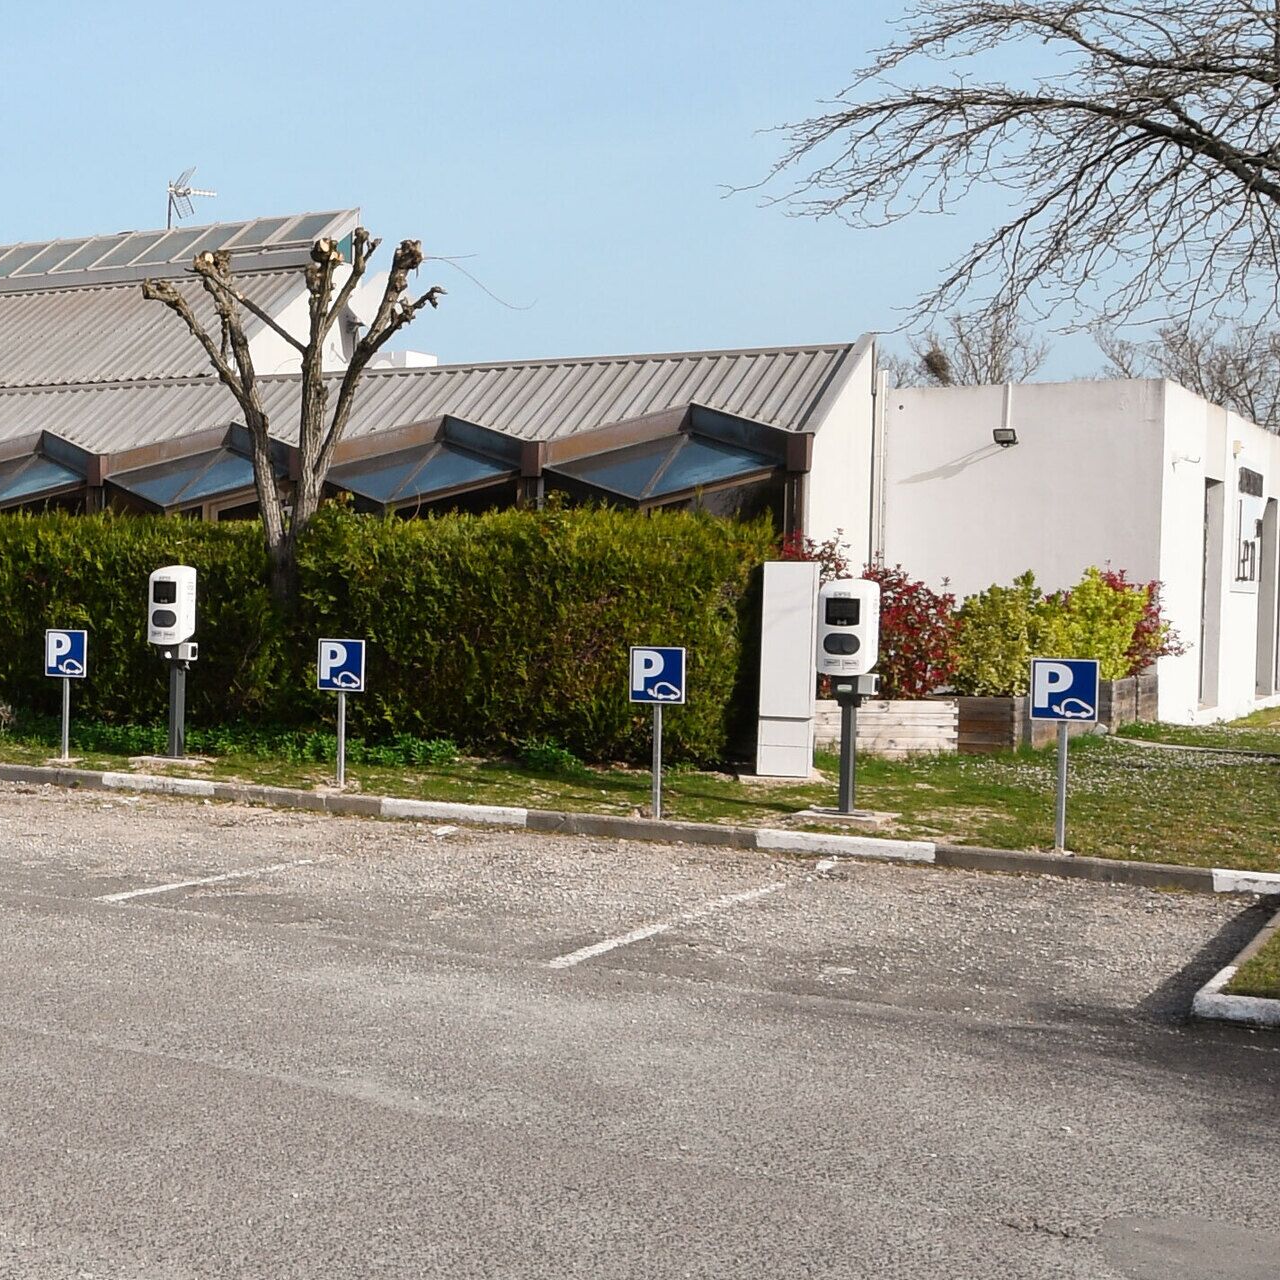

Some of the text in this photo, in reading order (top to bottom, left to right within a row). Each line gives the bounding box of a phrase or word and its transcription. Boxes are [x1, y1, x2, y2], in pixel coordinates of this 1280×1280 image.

[47, 632, 72, 668] P
[320, 642, 348, 680] P
[632, 650, 665, 691] P
[1034, 662, 1074, 708] P
